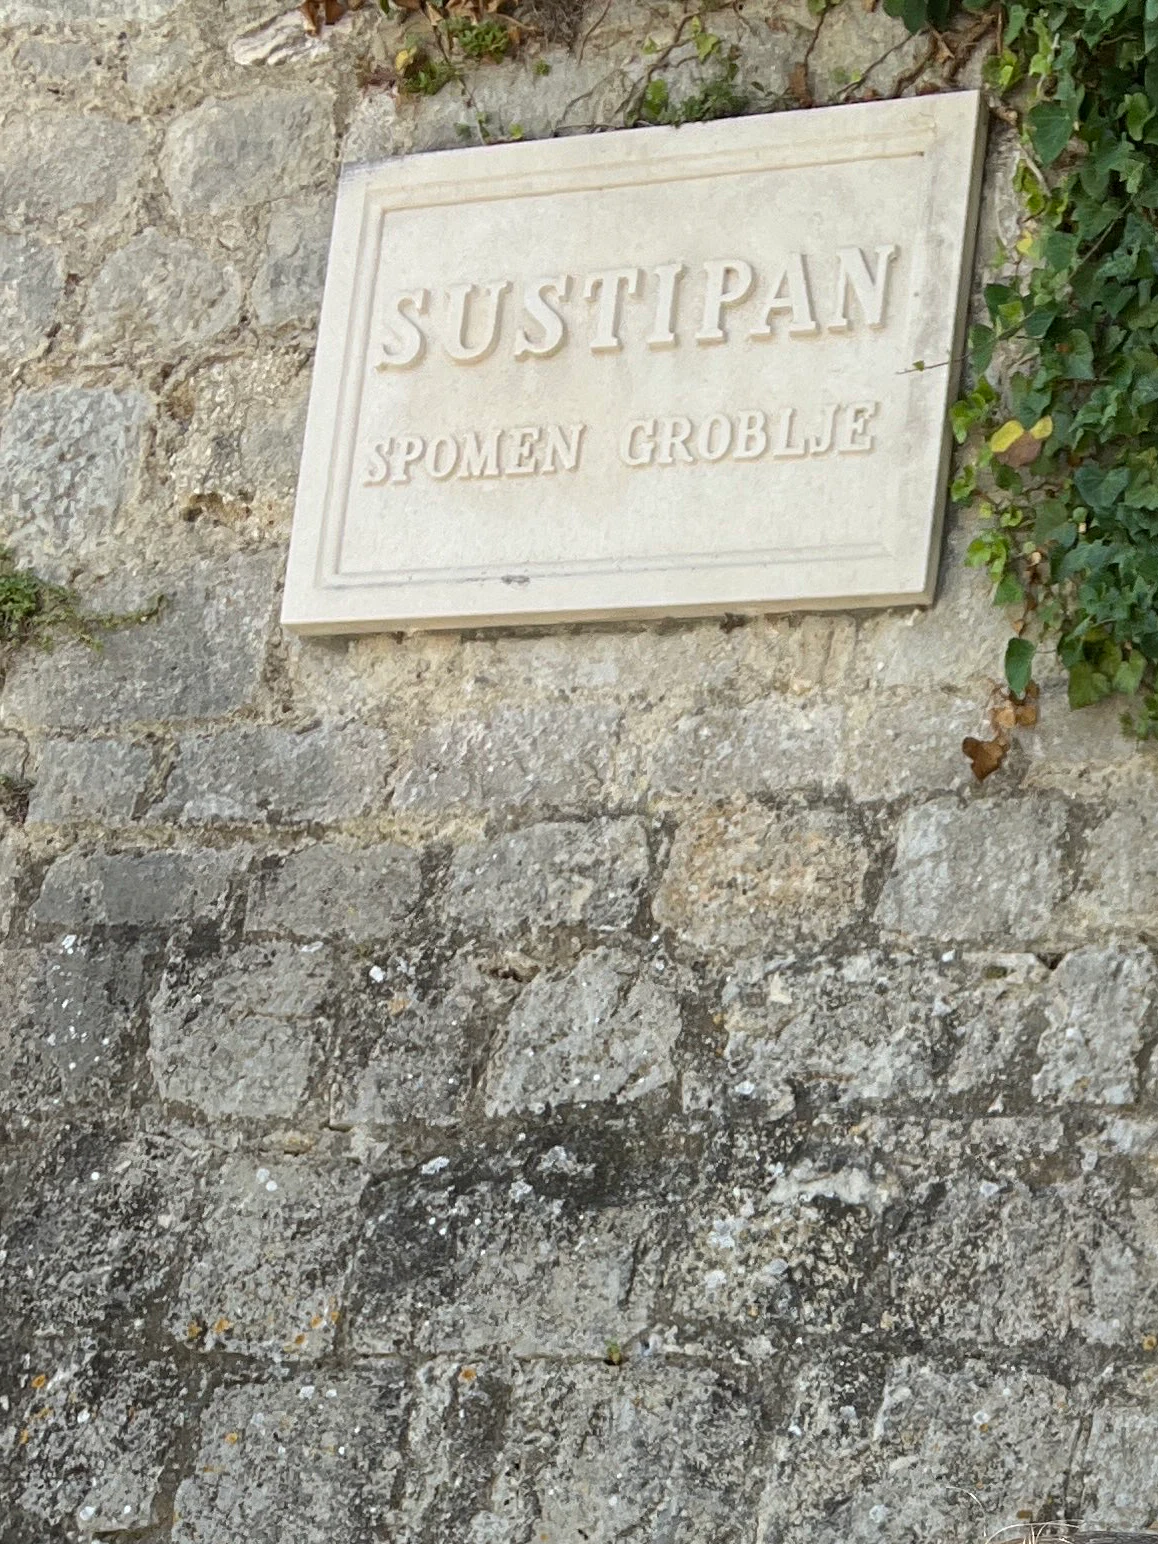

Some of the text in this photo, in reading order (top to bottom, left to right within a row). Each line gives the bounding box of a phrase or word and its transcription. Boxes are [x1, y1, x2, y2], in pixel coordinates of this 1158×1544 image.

[374, 243, 899, 371] SUSTIPAN
[362, 401, 880, 487] SPOMEN GROBLJE
